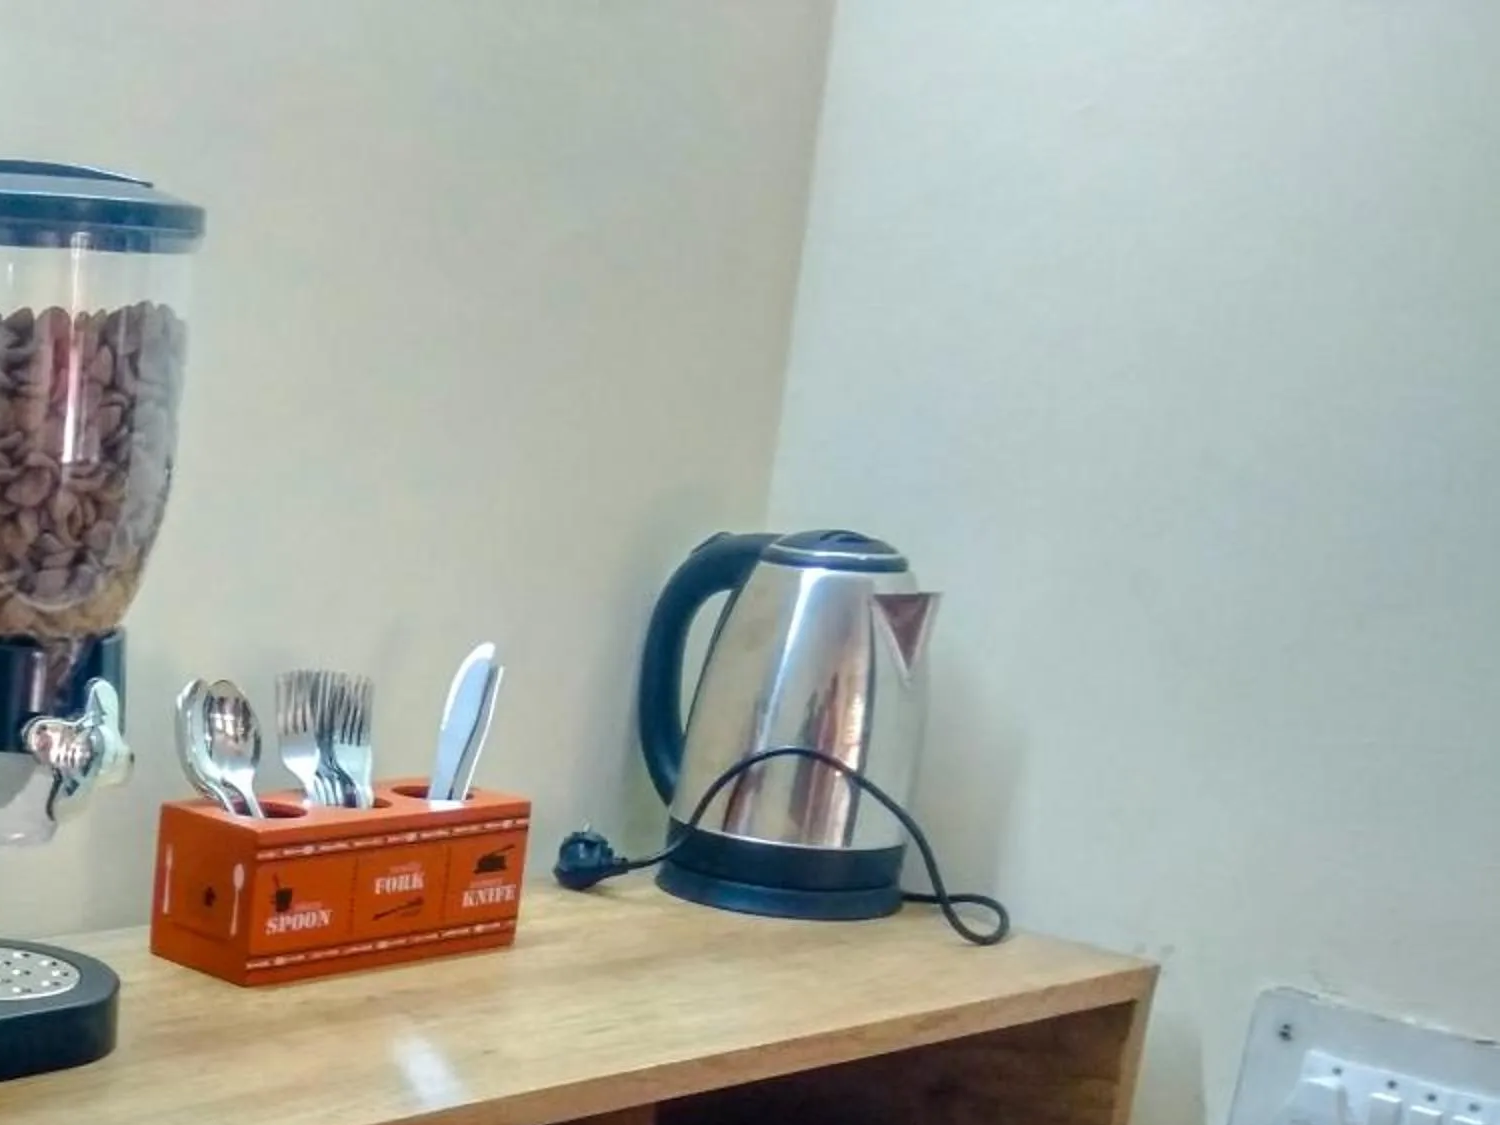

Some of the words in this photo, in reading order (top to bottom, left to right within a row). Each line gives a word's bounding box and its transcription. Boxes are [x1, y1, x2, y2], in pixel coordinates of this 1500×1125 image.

[374, 872, 425, 895] FORK
[462, 884, 517, 907] KNIFE
[265, 910, 331, 935] SPOON
